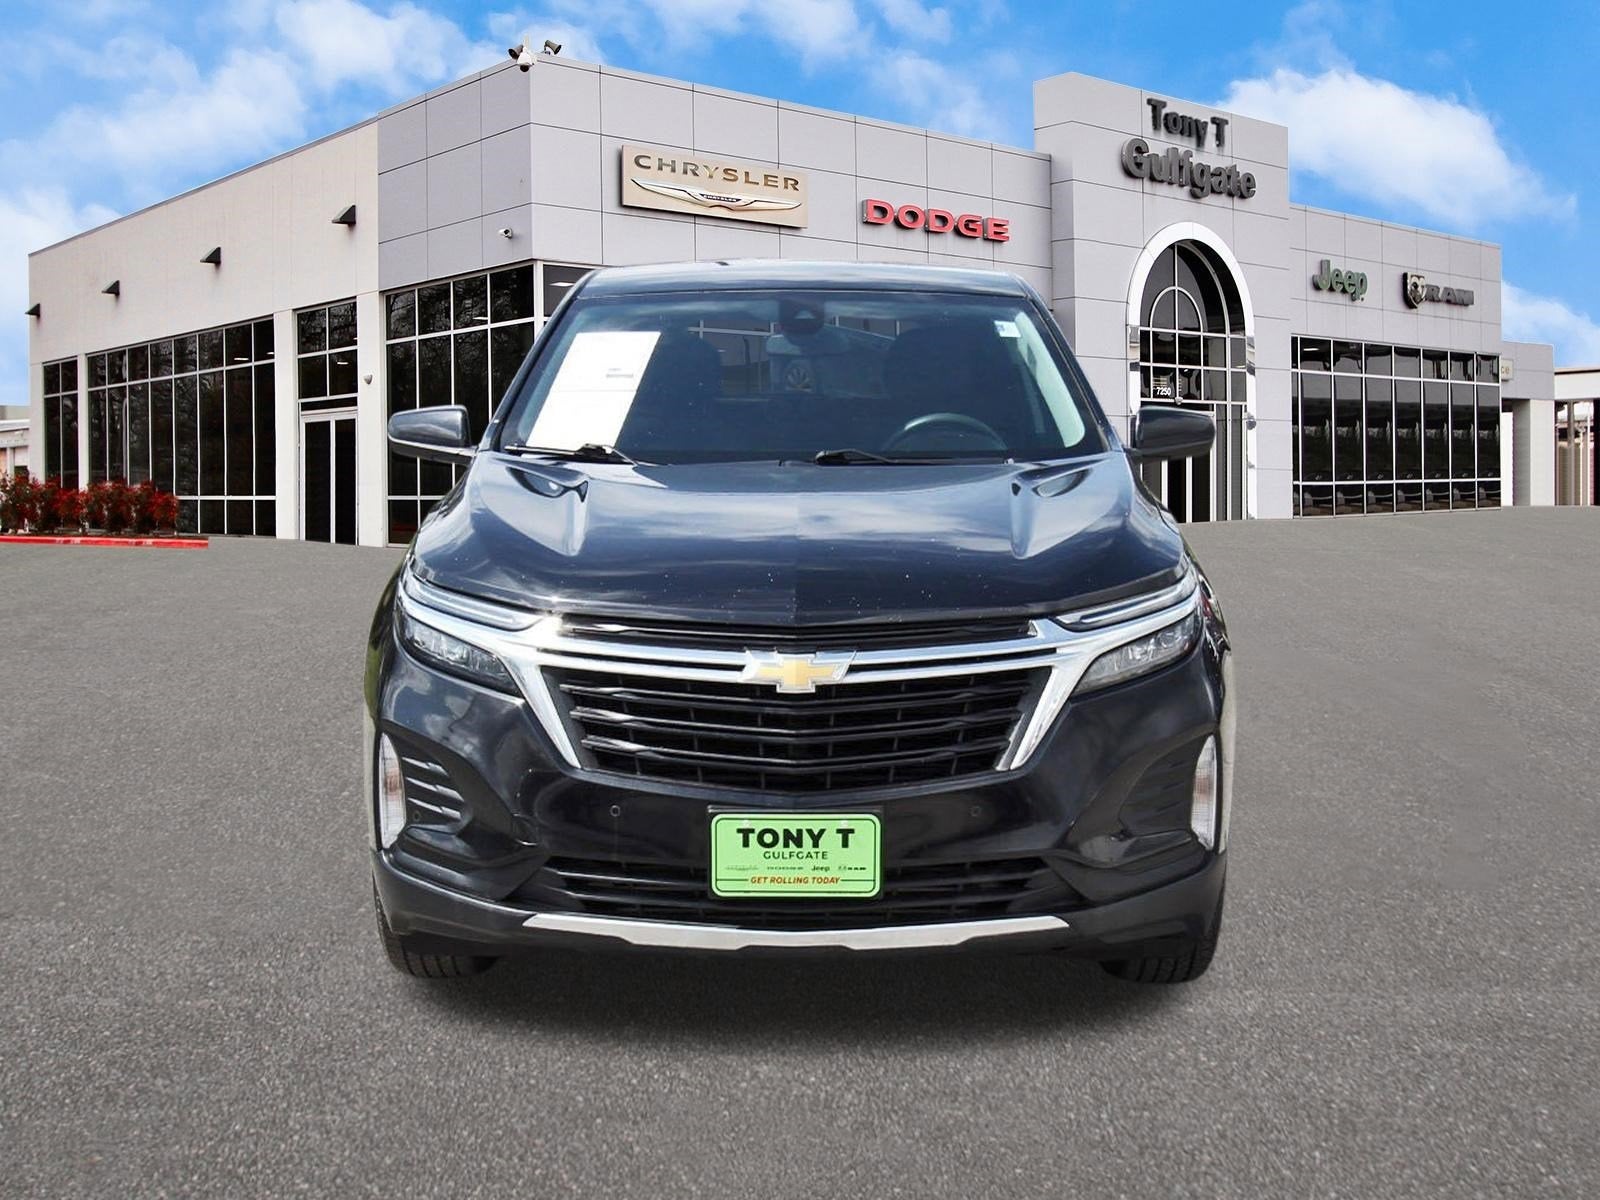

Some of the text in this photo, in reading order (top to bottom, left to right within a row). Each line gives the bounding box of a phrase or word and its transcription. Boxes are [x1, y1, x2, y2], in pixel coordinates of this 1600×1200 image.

[1146, 98, 1229, 147] Tony T
[633, 153, 800, 191] CHRYSLER
[1121, 138, 1256, 199] Gulfgate
[862, 199, 1010, 242] DODGE
[1312, 259, 1367, 302] Jeep
[1424, 283, 1474, 306] RAM
[1156, 386, 1172, 396] 7250
[736, 828, 855, 848] TONY T
[763, 850, 828, 860] GULFGATE
[750, 876, 841, 885] GET ROLLING TODAY
